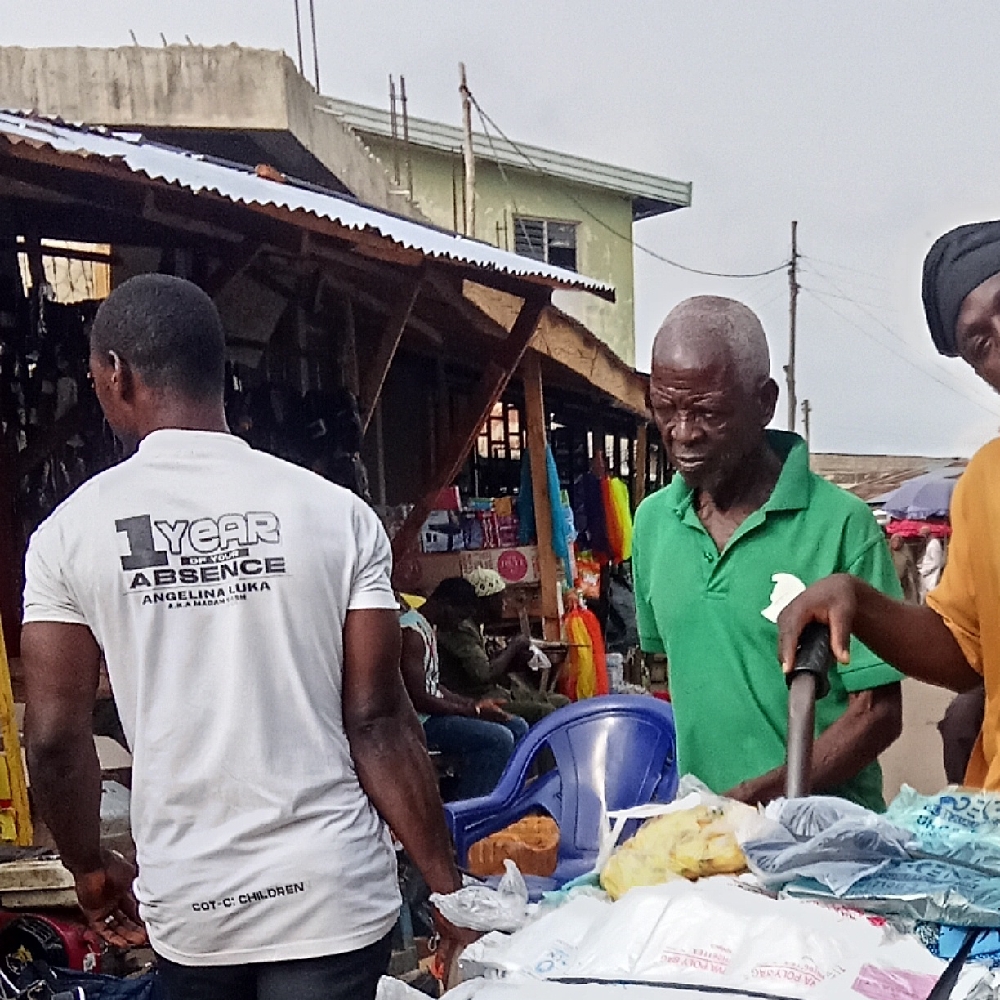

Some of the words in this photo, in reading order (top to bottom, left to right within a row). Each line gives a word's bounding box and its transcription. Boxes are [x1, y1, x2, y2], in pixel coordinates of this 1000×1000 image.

[115, 514, 168, 571] 1
[130, 557, 286, 589] ABSENCE
[142, 586, 226, 605] ANGELINA
[228, 581, 271, 595] LUKA
[239, 882, 304, 904] CHILDREN
